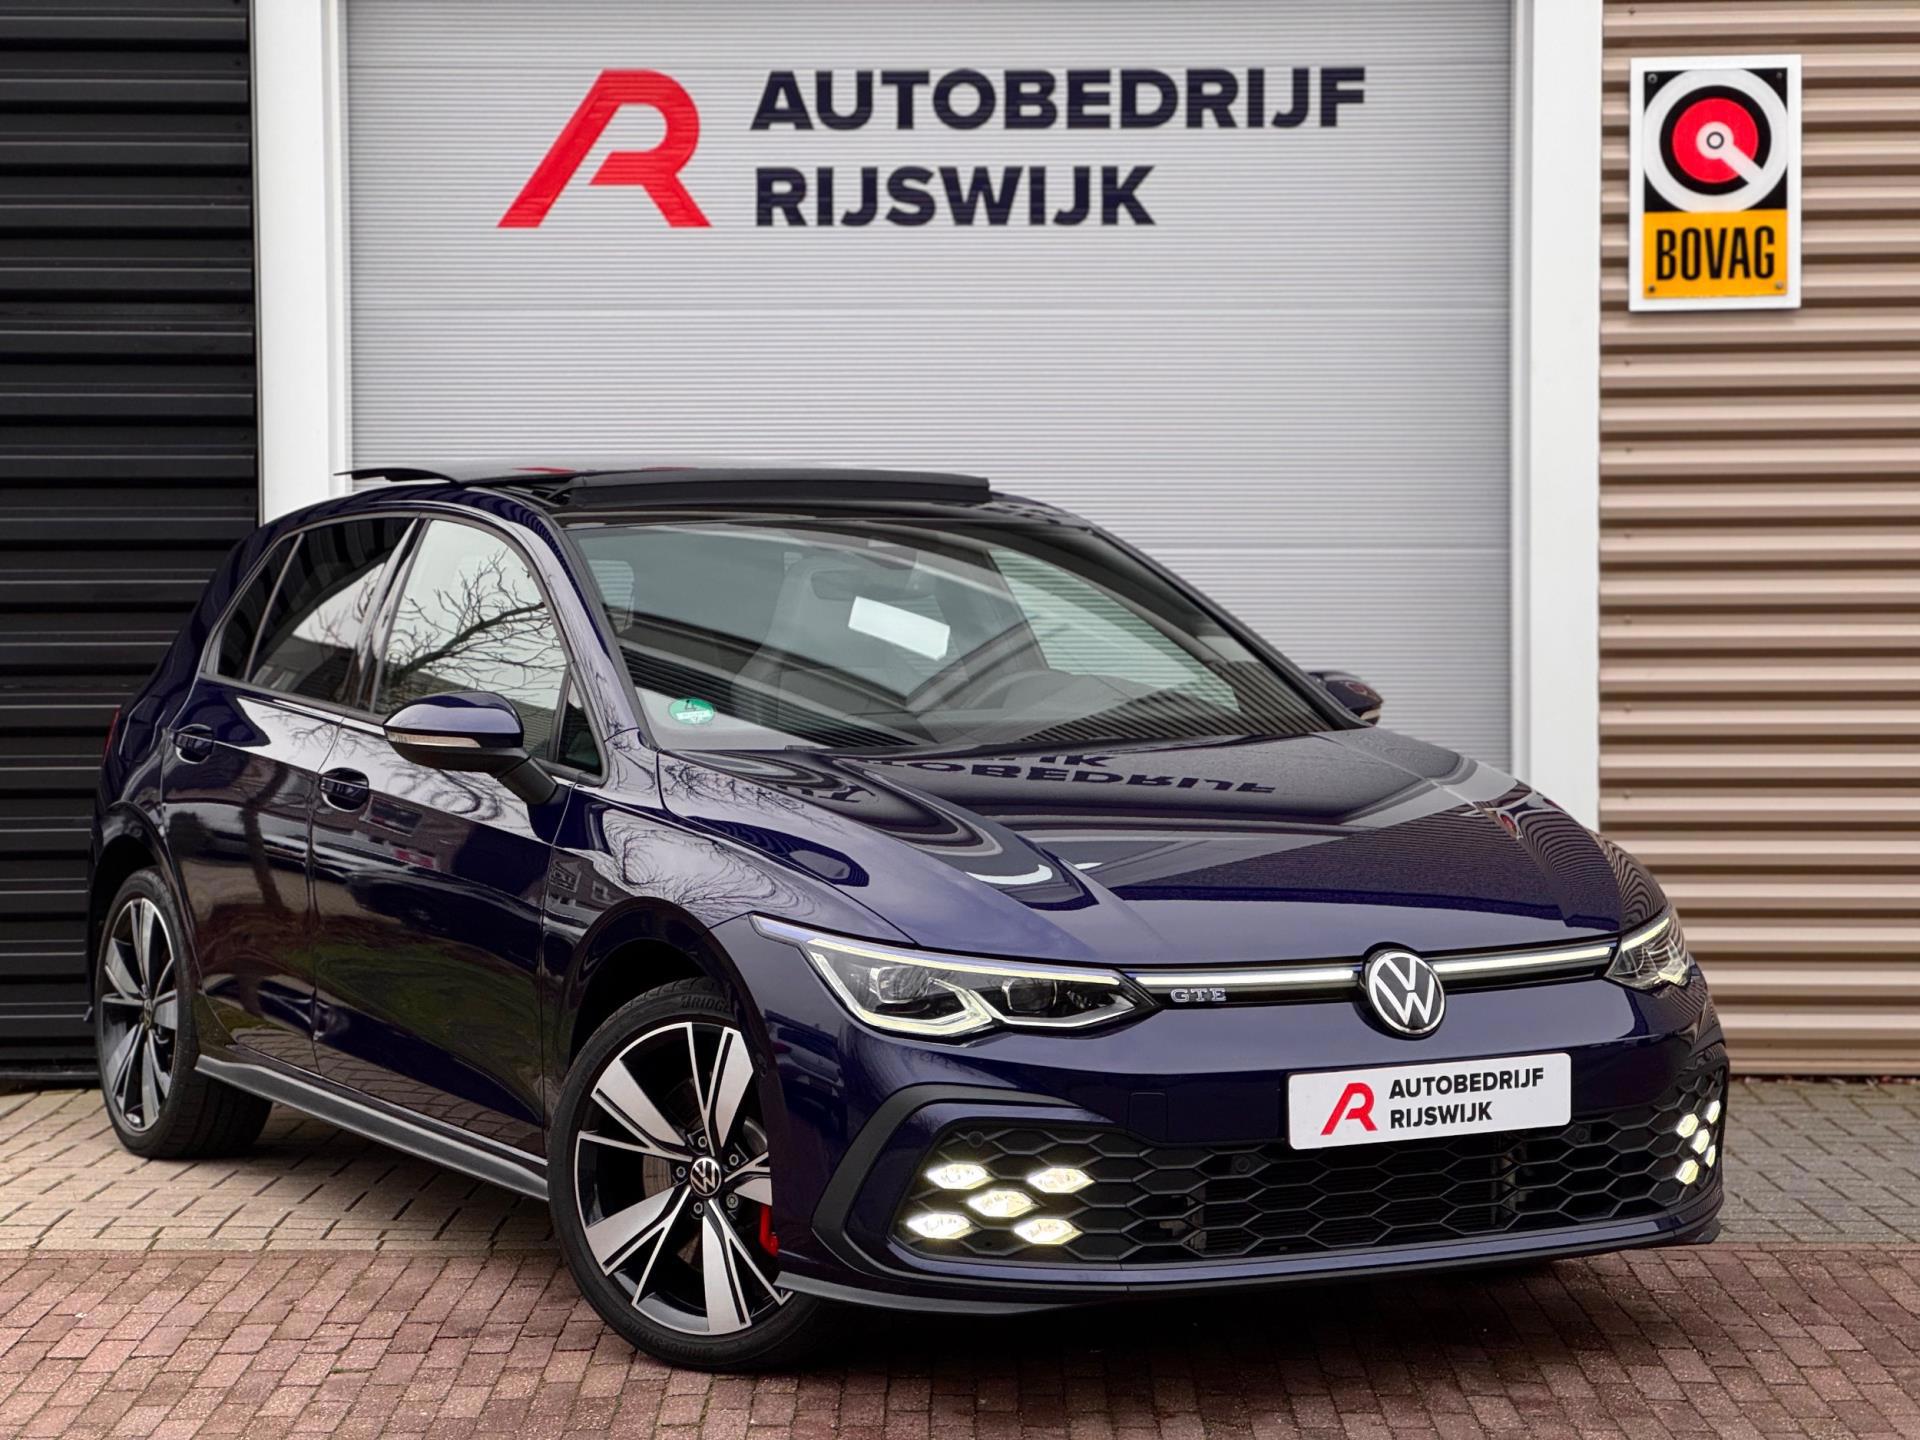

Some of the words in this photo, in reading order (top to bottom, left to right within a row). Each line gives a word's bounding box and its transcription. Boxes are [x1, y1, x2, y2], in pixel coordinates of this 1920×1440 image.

[751, 66, 1366, 131] AUTOBEDRIJF
[755, 165, 1156, 227] RIJSWIJK
[1656, 225, 1775, 281] BOVAG
[1170, 987, 1227, 1003] GTE
[1389, 1067, 1544, 1100] AUTOBEDRIJF
[1390, 1101, 1493, 1130] RIJSWIJK
